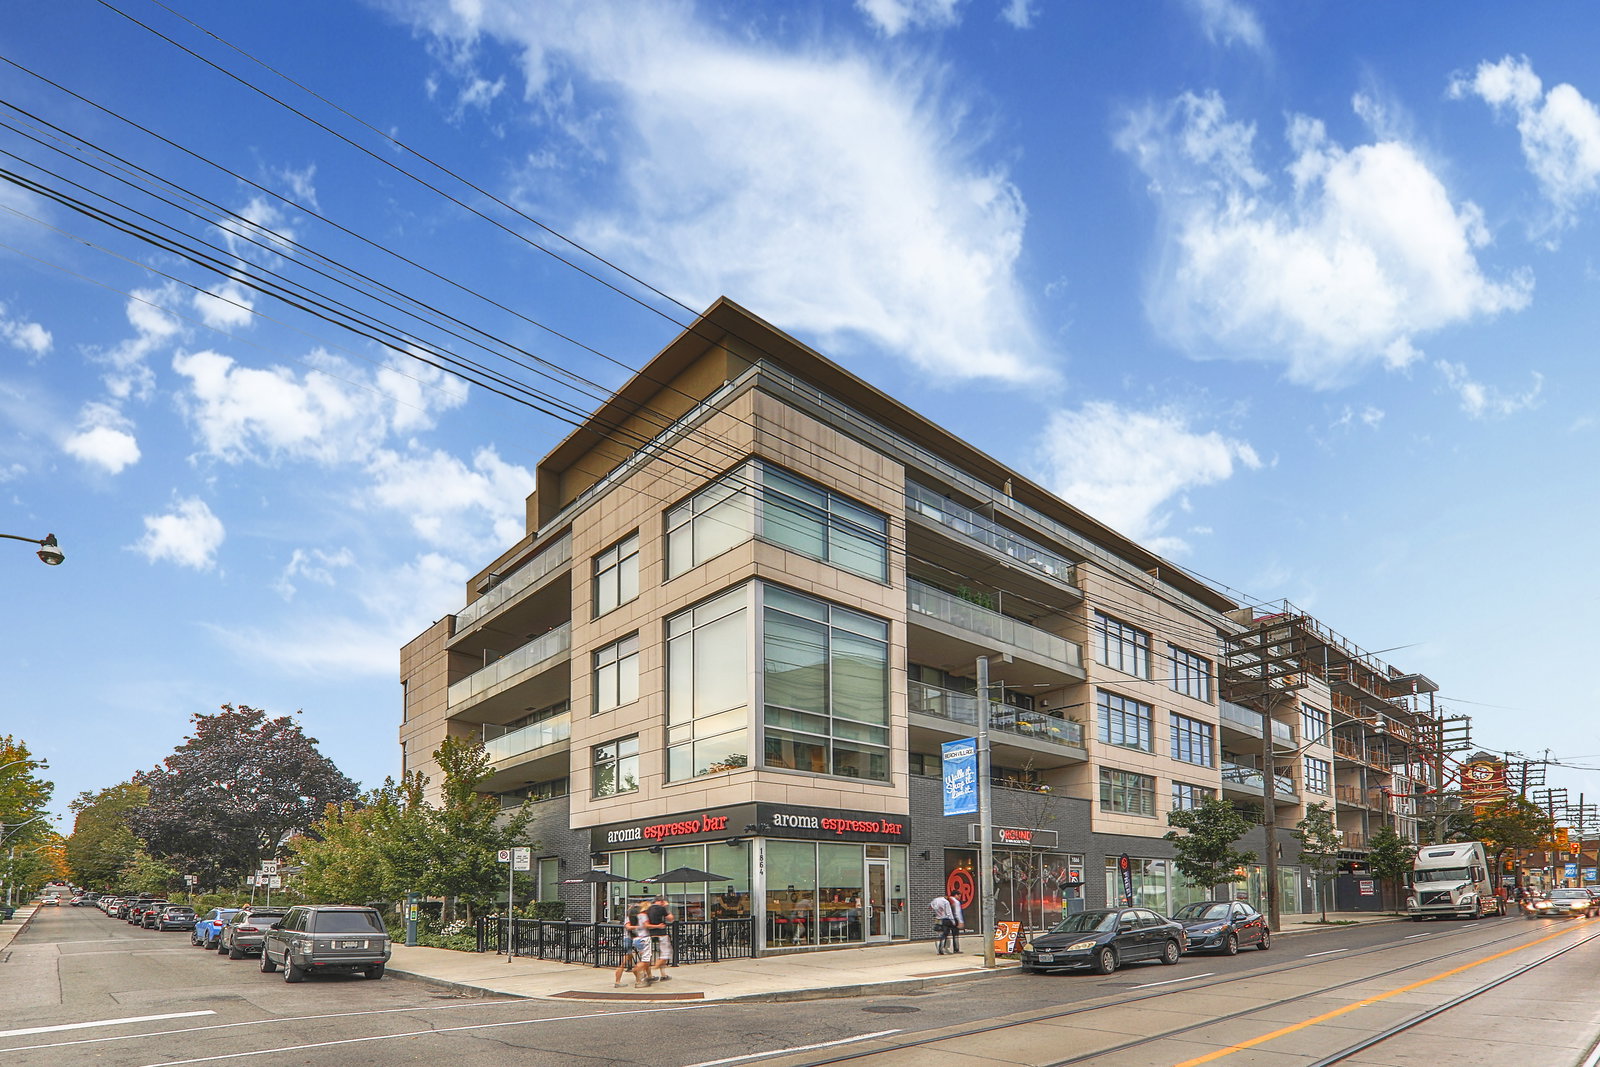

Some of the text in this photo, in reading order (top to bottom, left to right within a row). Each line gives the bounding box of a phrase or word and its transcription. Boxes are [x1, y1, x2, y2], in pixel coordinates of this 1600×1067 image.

[607, 814, 729, 843] aroma espresso bar
[773, 812, 902, 835] aroma espresso bar
